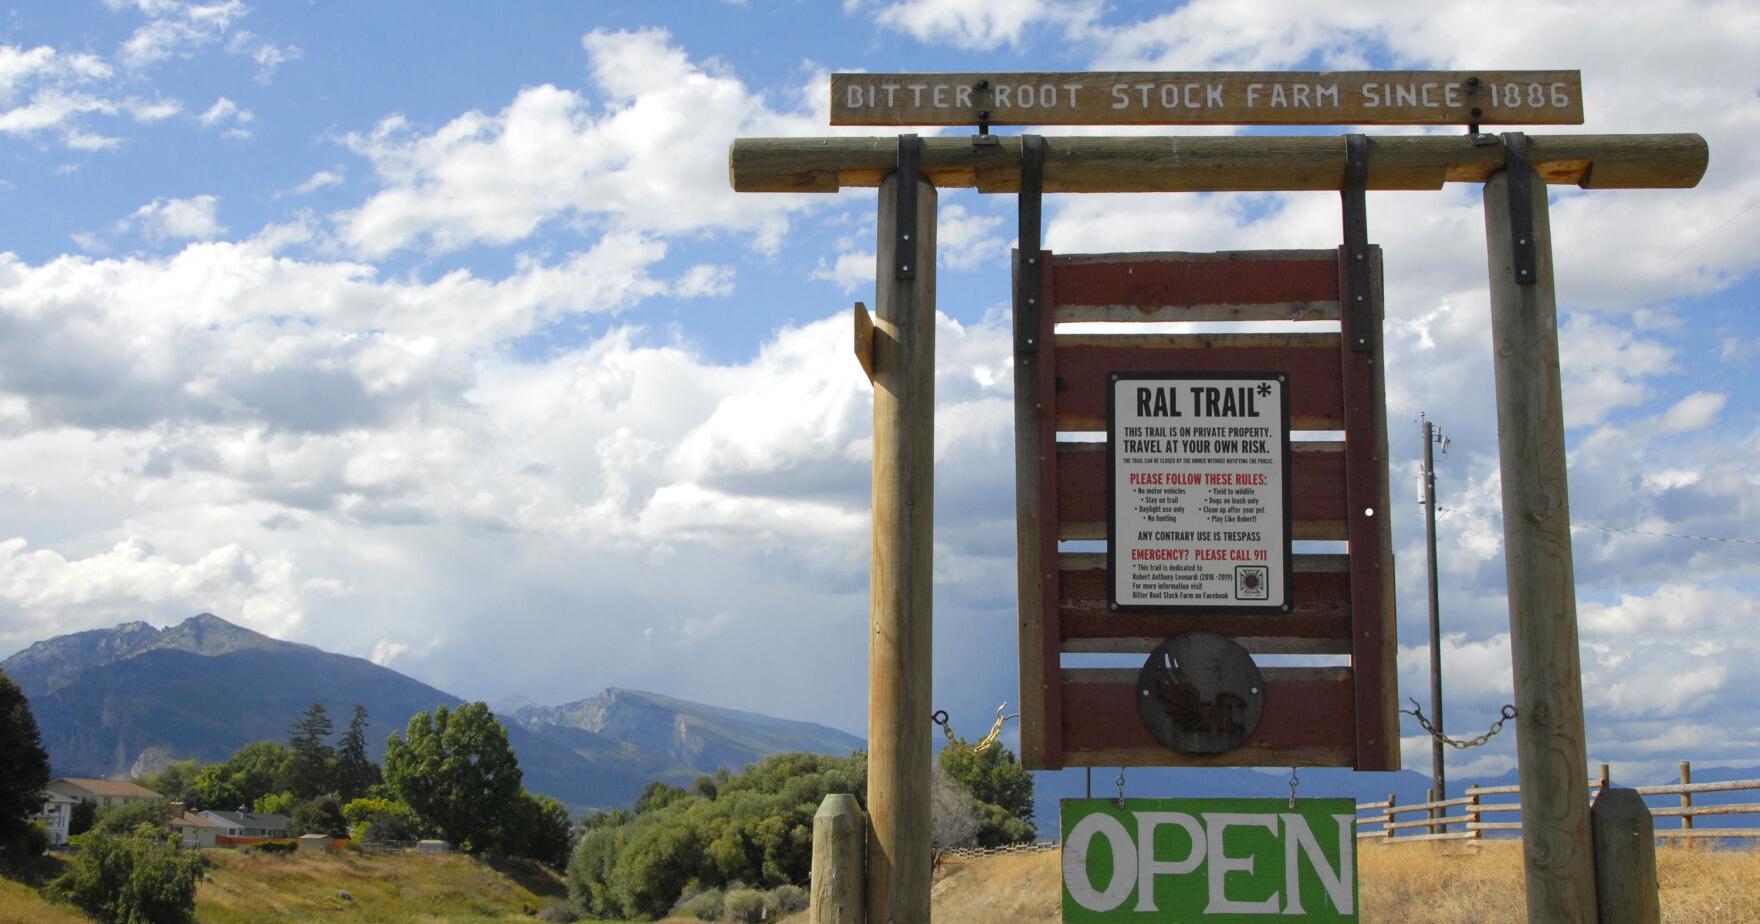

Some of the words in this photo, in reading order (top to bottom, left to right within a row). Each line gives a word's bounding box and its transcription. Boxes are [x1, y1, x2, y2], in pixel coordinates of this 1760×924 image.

[847, 83, 973, 109] BITTER
[994, 83, 1084, 109] ROOT
[1111, 83, 1225, 110] STOCK
[1247, 82, 1340, 108] FARM
[1361, 82, 1464, 108] SINCE
[1490, 81, 1570, 109] 1886
[1137, 387, 1182, 417] RAL
[1124, 427, 1142, 438] THIS
[1145, 427, 1167, 438] TRAIL
[1169, 427, 1177, 438] IS
[1180, 427, 1191, 438] ON
[1193, 427, 1226, 438] PRIVATE
[1228, 427, 1272, 438] PROPERTY.
[1124, 440, 1162, 453] TRAVEL
[1166, 440, 1179, 453] AT
[1182, 440, 1211, 453] YOUR
[1214, 440, 1238, 453] OWN
[1242, 440, 1270, 453] RISK.
[1130, 473, 1163, 485] PLEASE
[1166, 473, 1201, 485] FOLLOW
[1205, 473, 1232, 485] THESE
[1236, 473, 1267, 485] RULES:
[1145, 496, 1157, 504] Stay
[1209, 497, 1222, 505] Dogs
[1247, 497, 1259, 505] only
[1139, 505, 1161, 513] Daylight
[1173, 506, 1185, 514] only
[1219, 507, 1226, 515] up
[1156, 515, 1177, 523] hunting
[1211, 515, 1223, 524] Play
[1138, 531, 1153, 542] ANY
[1155, 531, 1194, 542] CONTRARY
[1197, 531, 1211, 542] USE
[1214, 531, 1221, 542] IS
[1223, 531, 1261, 542] TRESPASS
[1131, 549, 1190, 561] EMERGENCY?
[1195, 549, 1227, 561] PLEASE
[1230, 549, 1251, 561] CALL
[1254, 549, 1267, 561] 911
[1152, 574, 1174, 582] Anthony
[1062, 811, 1356, 915] OPEN
